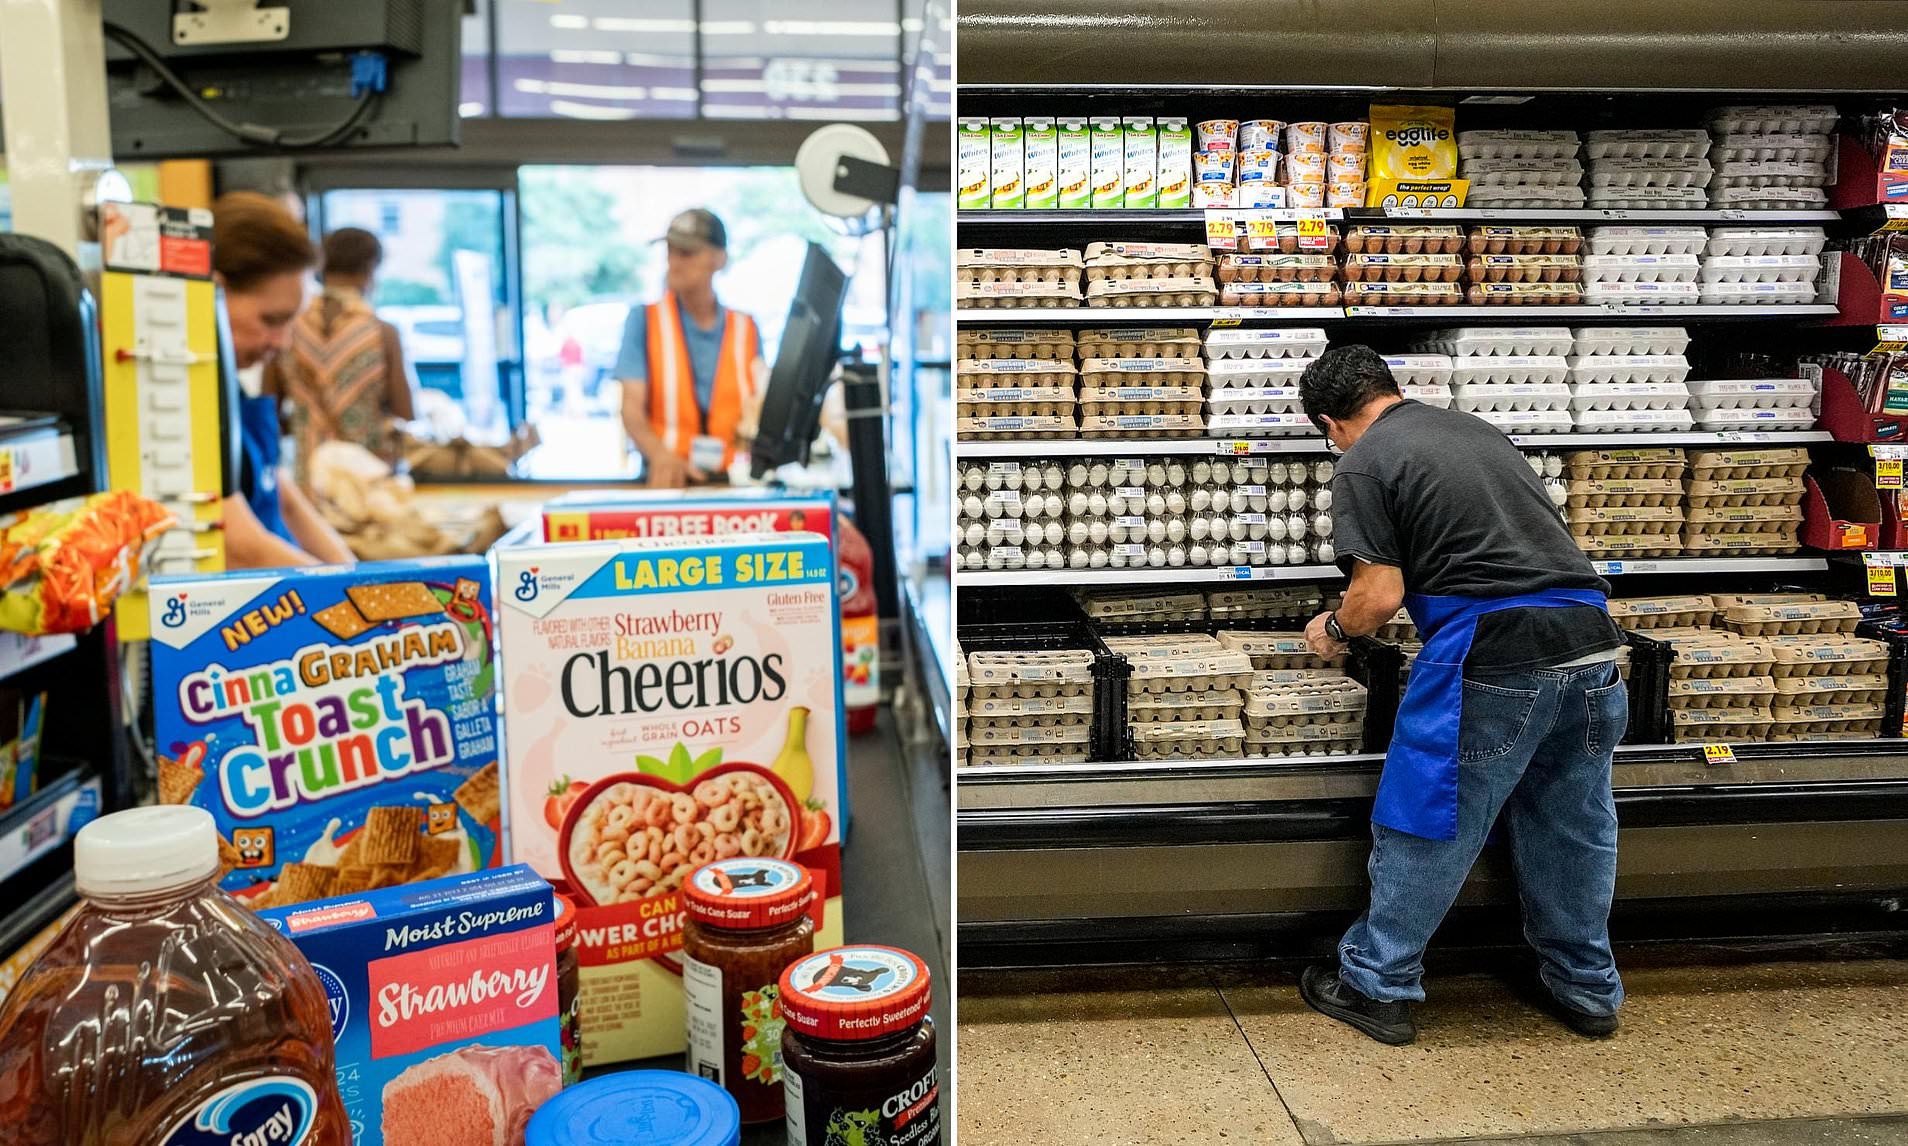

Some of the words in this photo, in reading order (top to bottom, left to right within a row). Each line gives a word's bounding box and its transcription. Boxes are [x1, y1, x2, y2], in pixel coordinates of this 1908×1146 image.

[1385, 127, 1449, 147] egglife
[1410, 183, 1432, 191] perfect
[1208, 223, 1233, 234] 2.79
[1249, 222, 1274, 233] 2.79
[1299, 220, 1325, 232] 2.79
[1878, 462, 1900, 470] 3/10.00
[635, 516, 646, 537] 1
[650, 513, 709, 537] FREE
[540, 573, 576, 584] General
[614, 556, 723, 590] LARGE
[735, 552, 805, 583] SIZE
[1869, 569, 1892, 577] 3/10.00
[767, 592, 802, 606] Gluten
[804, 591, 825, 604] Free
[220, 590, 307, 652] NEW!
[614, 609, 723, 637] Strawberry
[616, 636, 696, 661] Banana
[186, 665, 297, 715] Cinna
[300, 628, 458, 688] GRAHAM
[560, 650, 787, 718] Cheerios
[250, 675, 400, 752] Toast
[641, 722, 677, 733] WHOLE
[642, 731, 678, 742] GRAIN
[682, 716, 741, 738] OATS
[225, 705, 448, 809] Crunch
[458, 735, 495, 760] GRAHAM
[1705, 745, 1729, 755] 2.19
[290, 906, 369, 928] Strawberry
[639, 896, 677, 919] CAN
[707, 906, 726, 918] Cane
[727, 909, 752, 919] Sugar
[768, 902, 799, 916] Perfectly
[384, 920, 455, 952] Moist
[458, 902, 544, 935] Supreme
[606, 947, 620, 960] AS
[622, 941, 647, 957] PART
[647, 938, 659, 951] OF
[661, 937, 670, 949] A
[378, 963, 550, 1028] Strawberry
[797, 1011, 819, 1027] Sugar
[838, 1015, 881, 1029] Perfectly
[766, 1029, 780, 1041] 30
[882, 1064, 938, 1118] CROFT
[230, 1102, 293, 1146] Spray
[890, 1119, 928, 1146] Seedless
